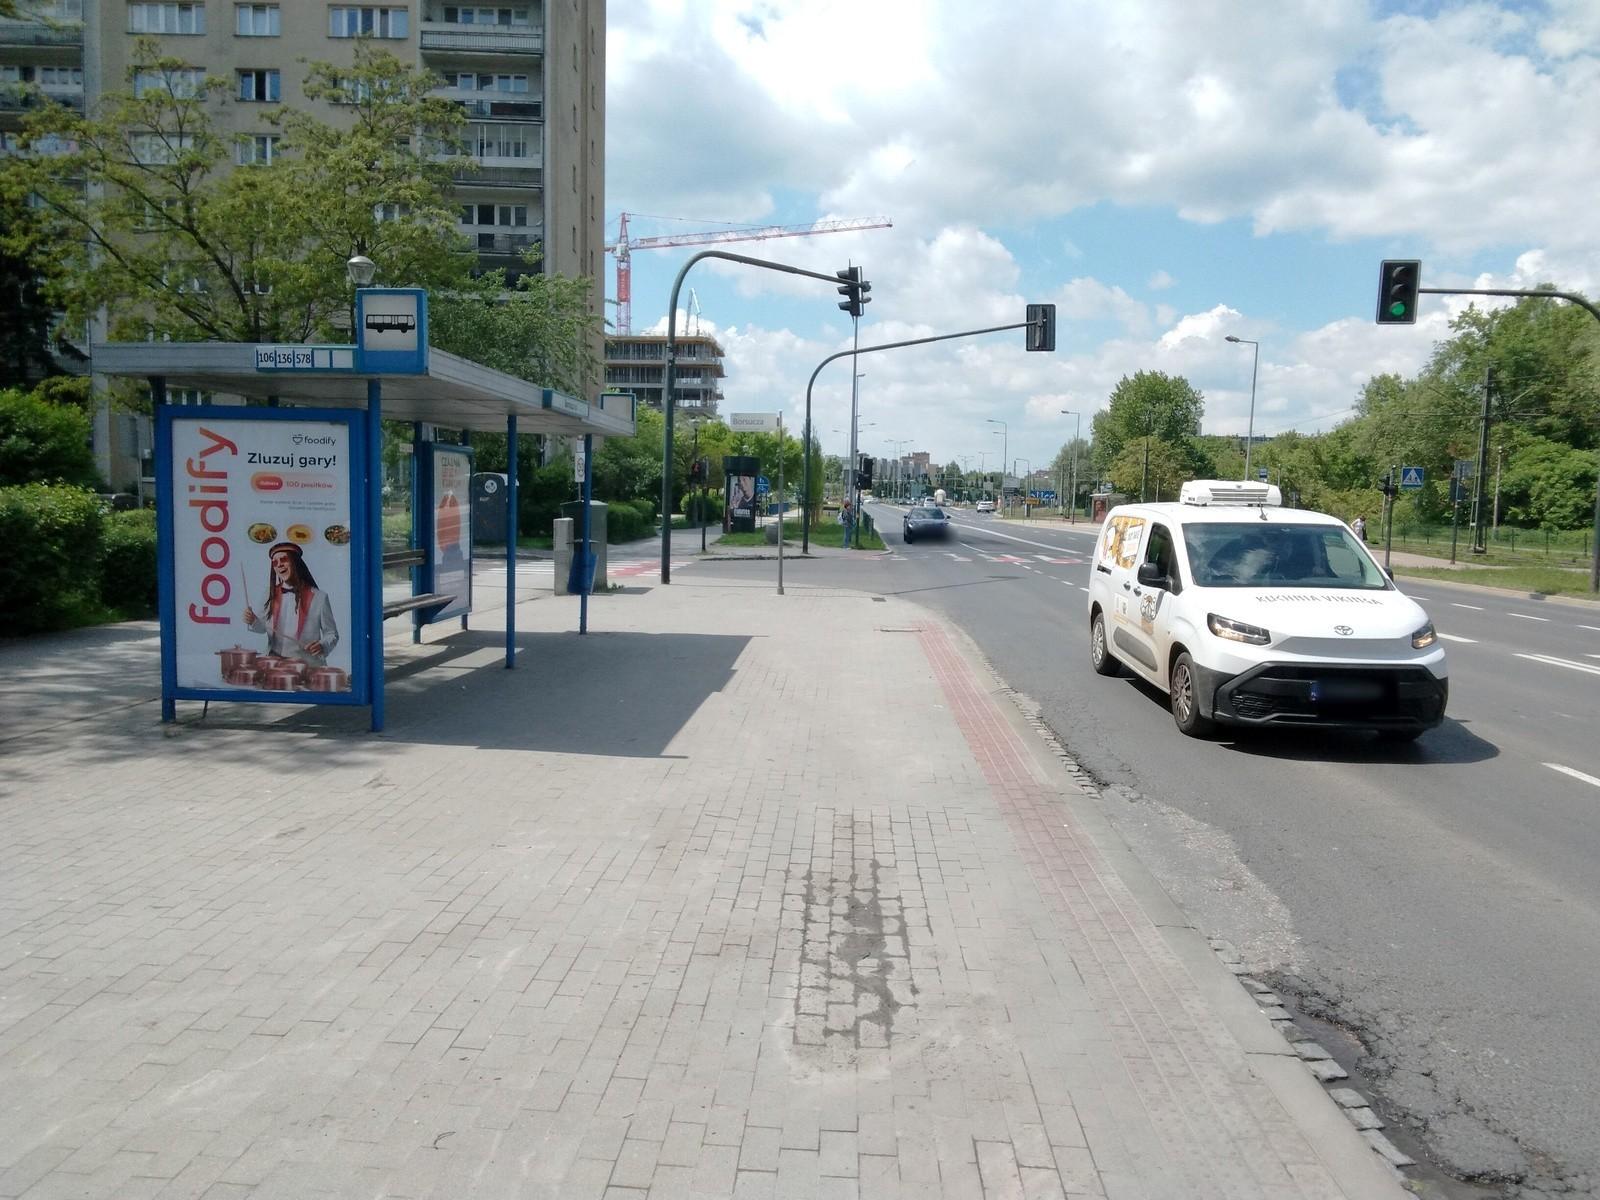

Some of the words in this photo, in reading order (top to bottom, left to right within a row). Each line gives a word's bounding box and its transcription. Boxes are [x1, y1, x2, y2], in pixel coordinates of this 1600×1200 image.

[258, 352, 275, 364] 106
[277, 353, 293, 365] 136
[296, 353, 311, 364] 578
[732, 417, 765, 426] Borsucza
[304, 434, 337, 447] foodify
[247, 452, 294, 467] Zluzuj
[298, 454, 337, 469] gary!
[286, 480, 299, 489] 100
[186, 427, 238, 625] foodify
